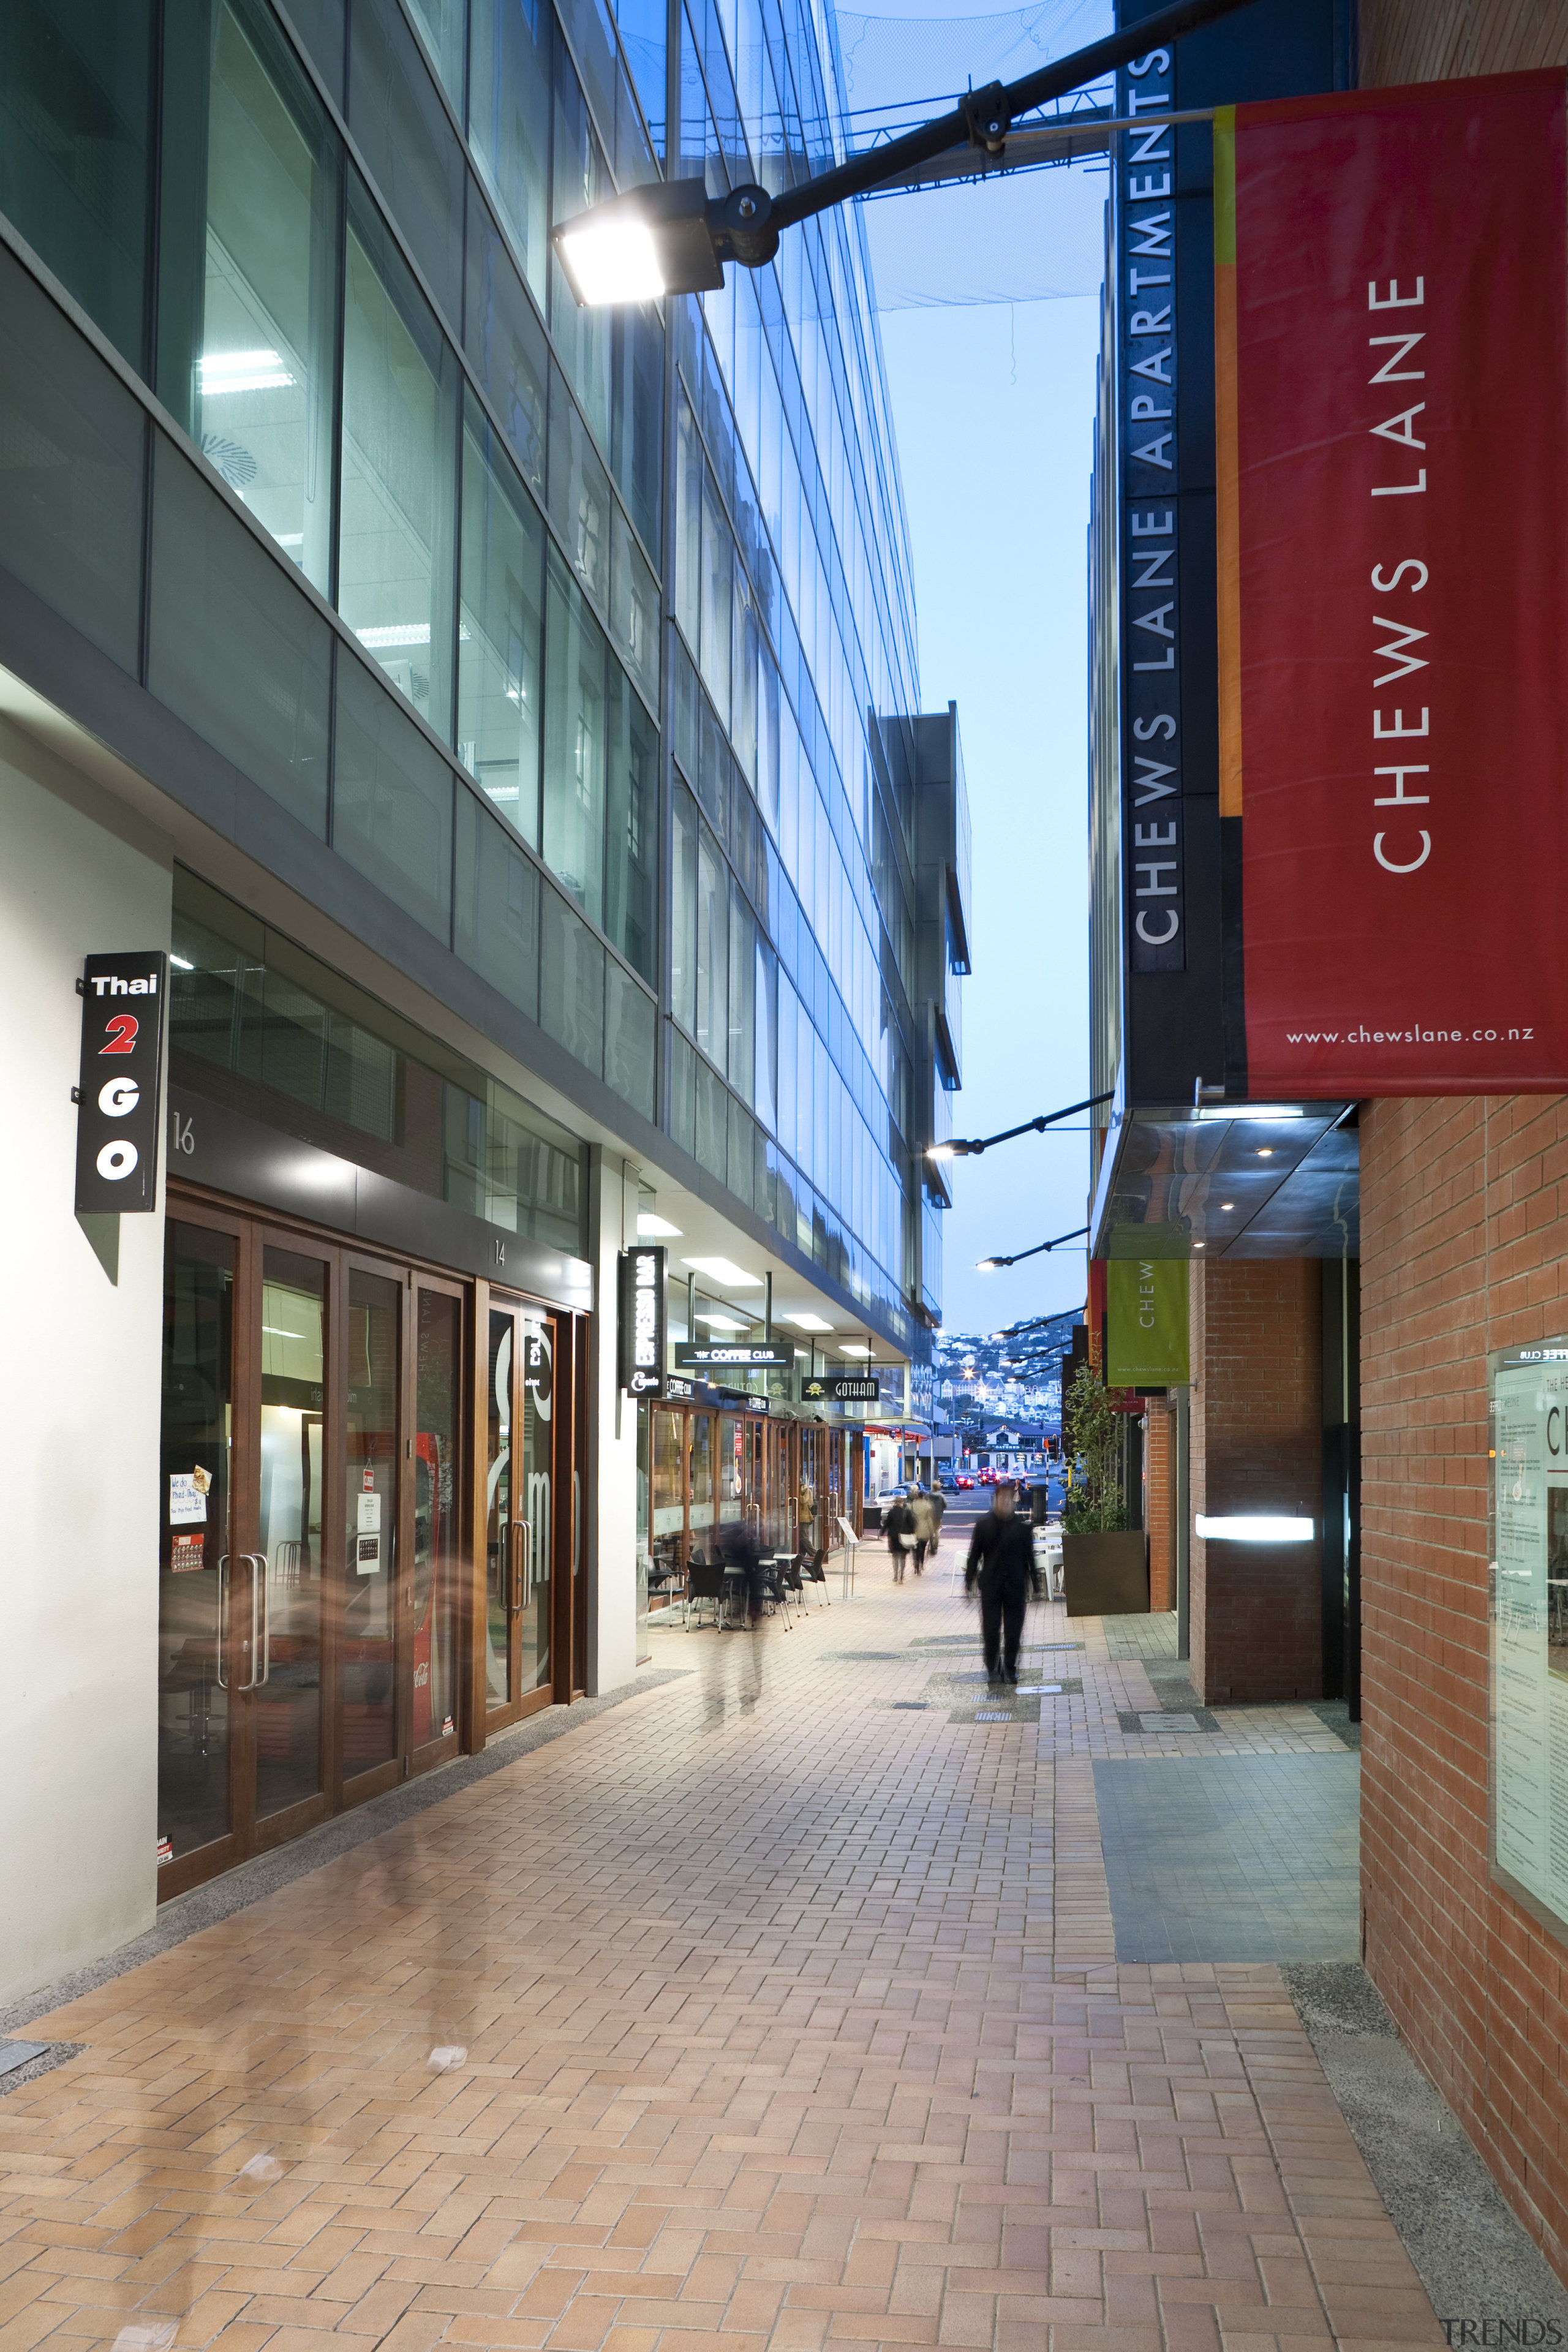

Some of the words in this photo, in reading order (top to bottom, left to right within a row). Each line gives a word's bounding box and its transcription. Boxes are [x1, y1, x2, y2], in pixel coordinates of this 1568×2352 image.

[1128, 47, 1174, 471] APARTMENTS
[1368, 275, 1428, 497] LANE
[1131, 510, 1177, 673] LANE
[1373, 558, 1431, 873] CHEWS
[1133, 712, 1179, 945] CHEWS
[91, 973, 157, 997] Thai
[98, 1014, 139, 1054] 2
[1286, 1023, 1534, 1044] www.chewslane.co.nz
[173, 1111, 195, 1155] 16
[495, 1240, 505, 1266] 14
[636, 1255, 655, 1286] BAR
[635, 1289, 655, 1366] ESPRESSO
[694, 1351, 710, 1359] THE
[710, 1349, 752, 1360] COFFEE
[752, 1351, 774, 1359] CLUB
[669, 1378, 684, 1395] COFFEE
[835, 1382, 875, 1397] GOTHAM
